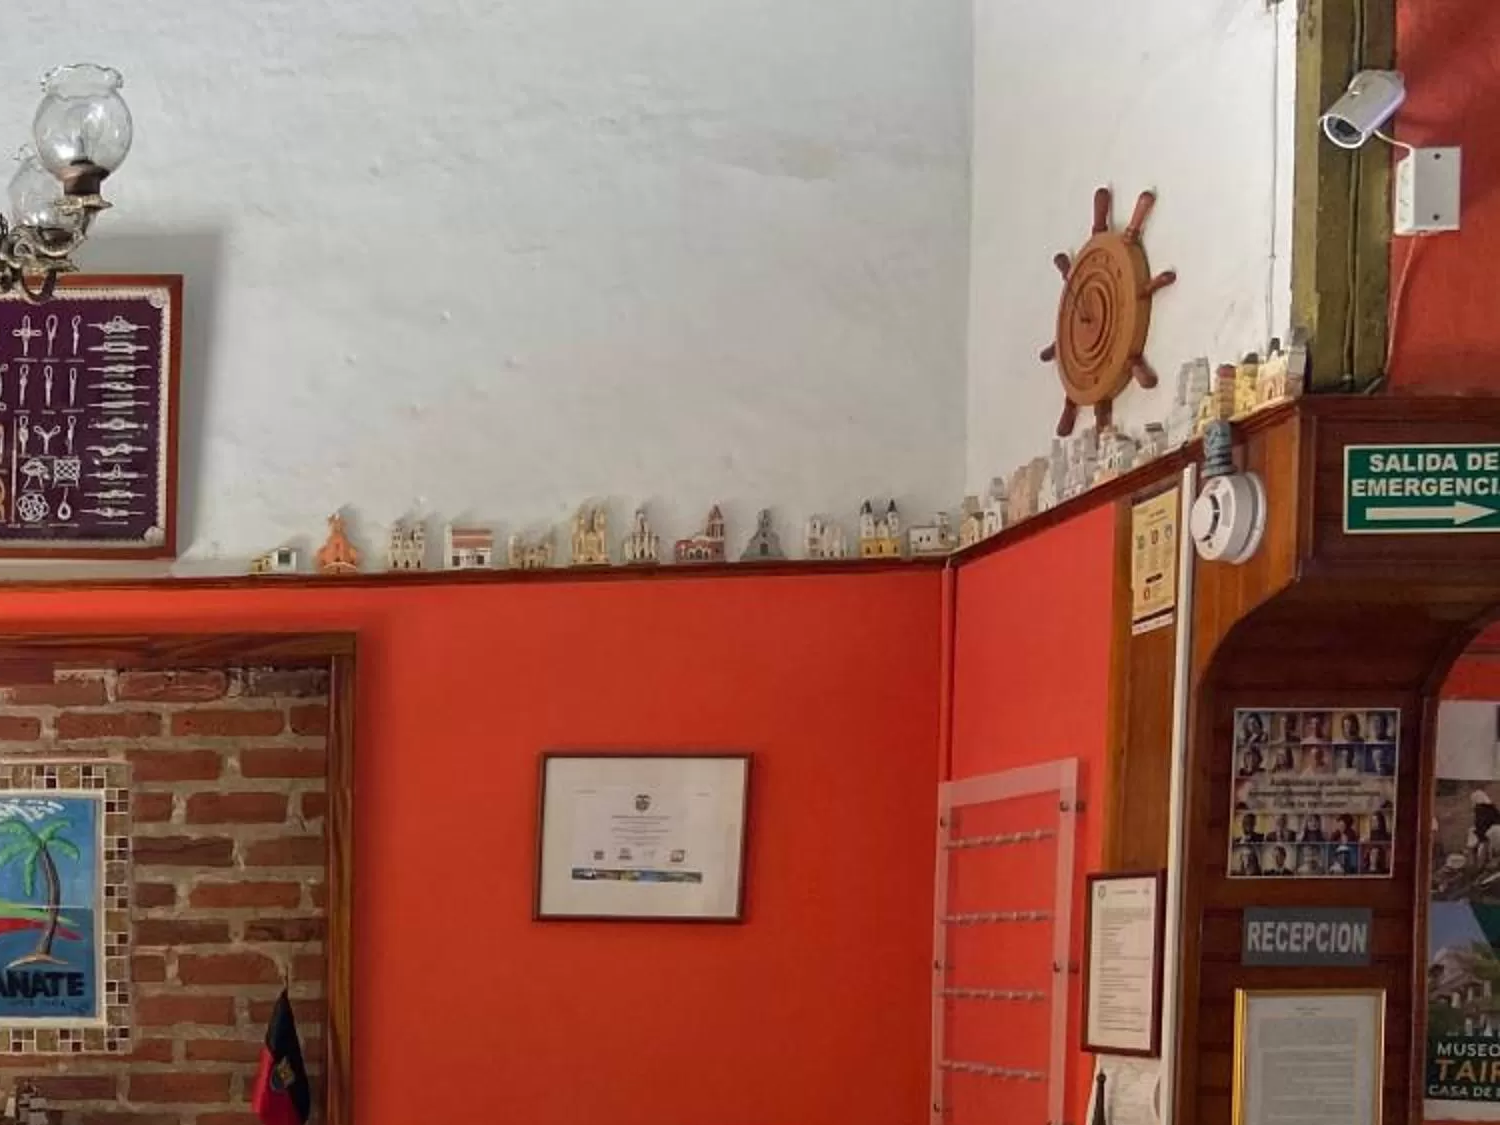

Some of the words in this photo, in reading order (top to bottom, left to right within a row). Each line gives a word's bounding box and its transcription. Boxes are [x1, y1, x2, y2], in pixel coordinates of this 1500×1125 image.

[1369, 453, 1459, 473] SALIDA
[1466, 451, 1500, 471] DE
[1247, 920, 1368, 954] RECEPCION
